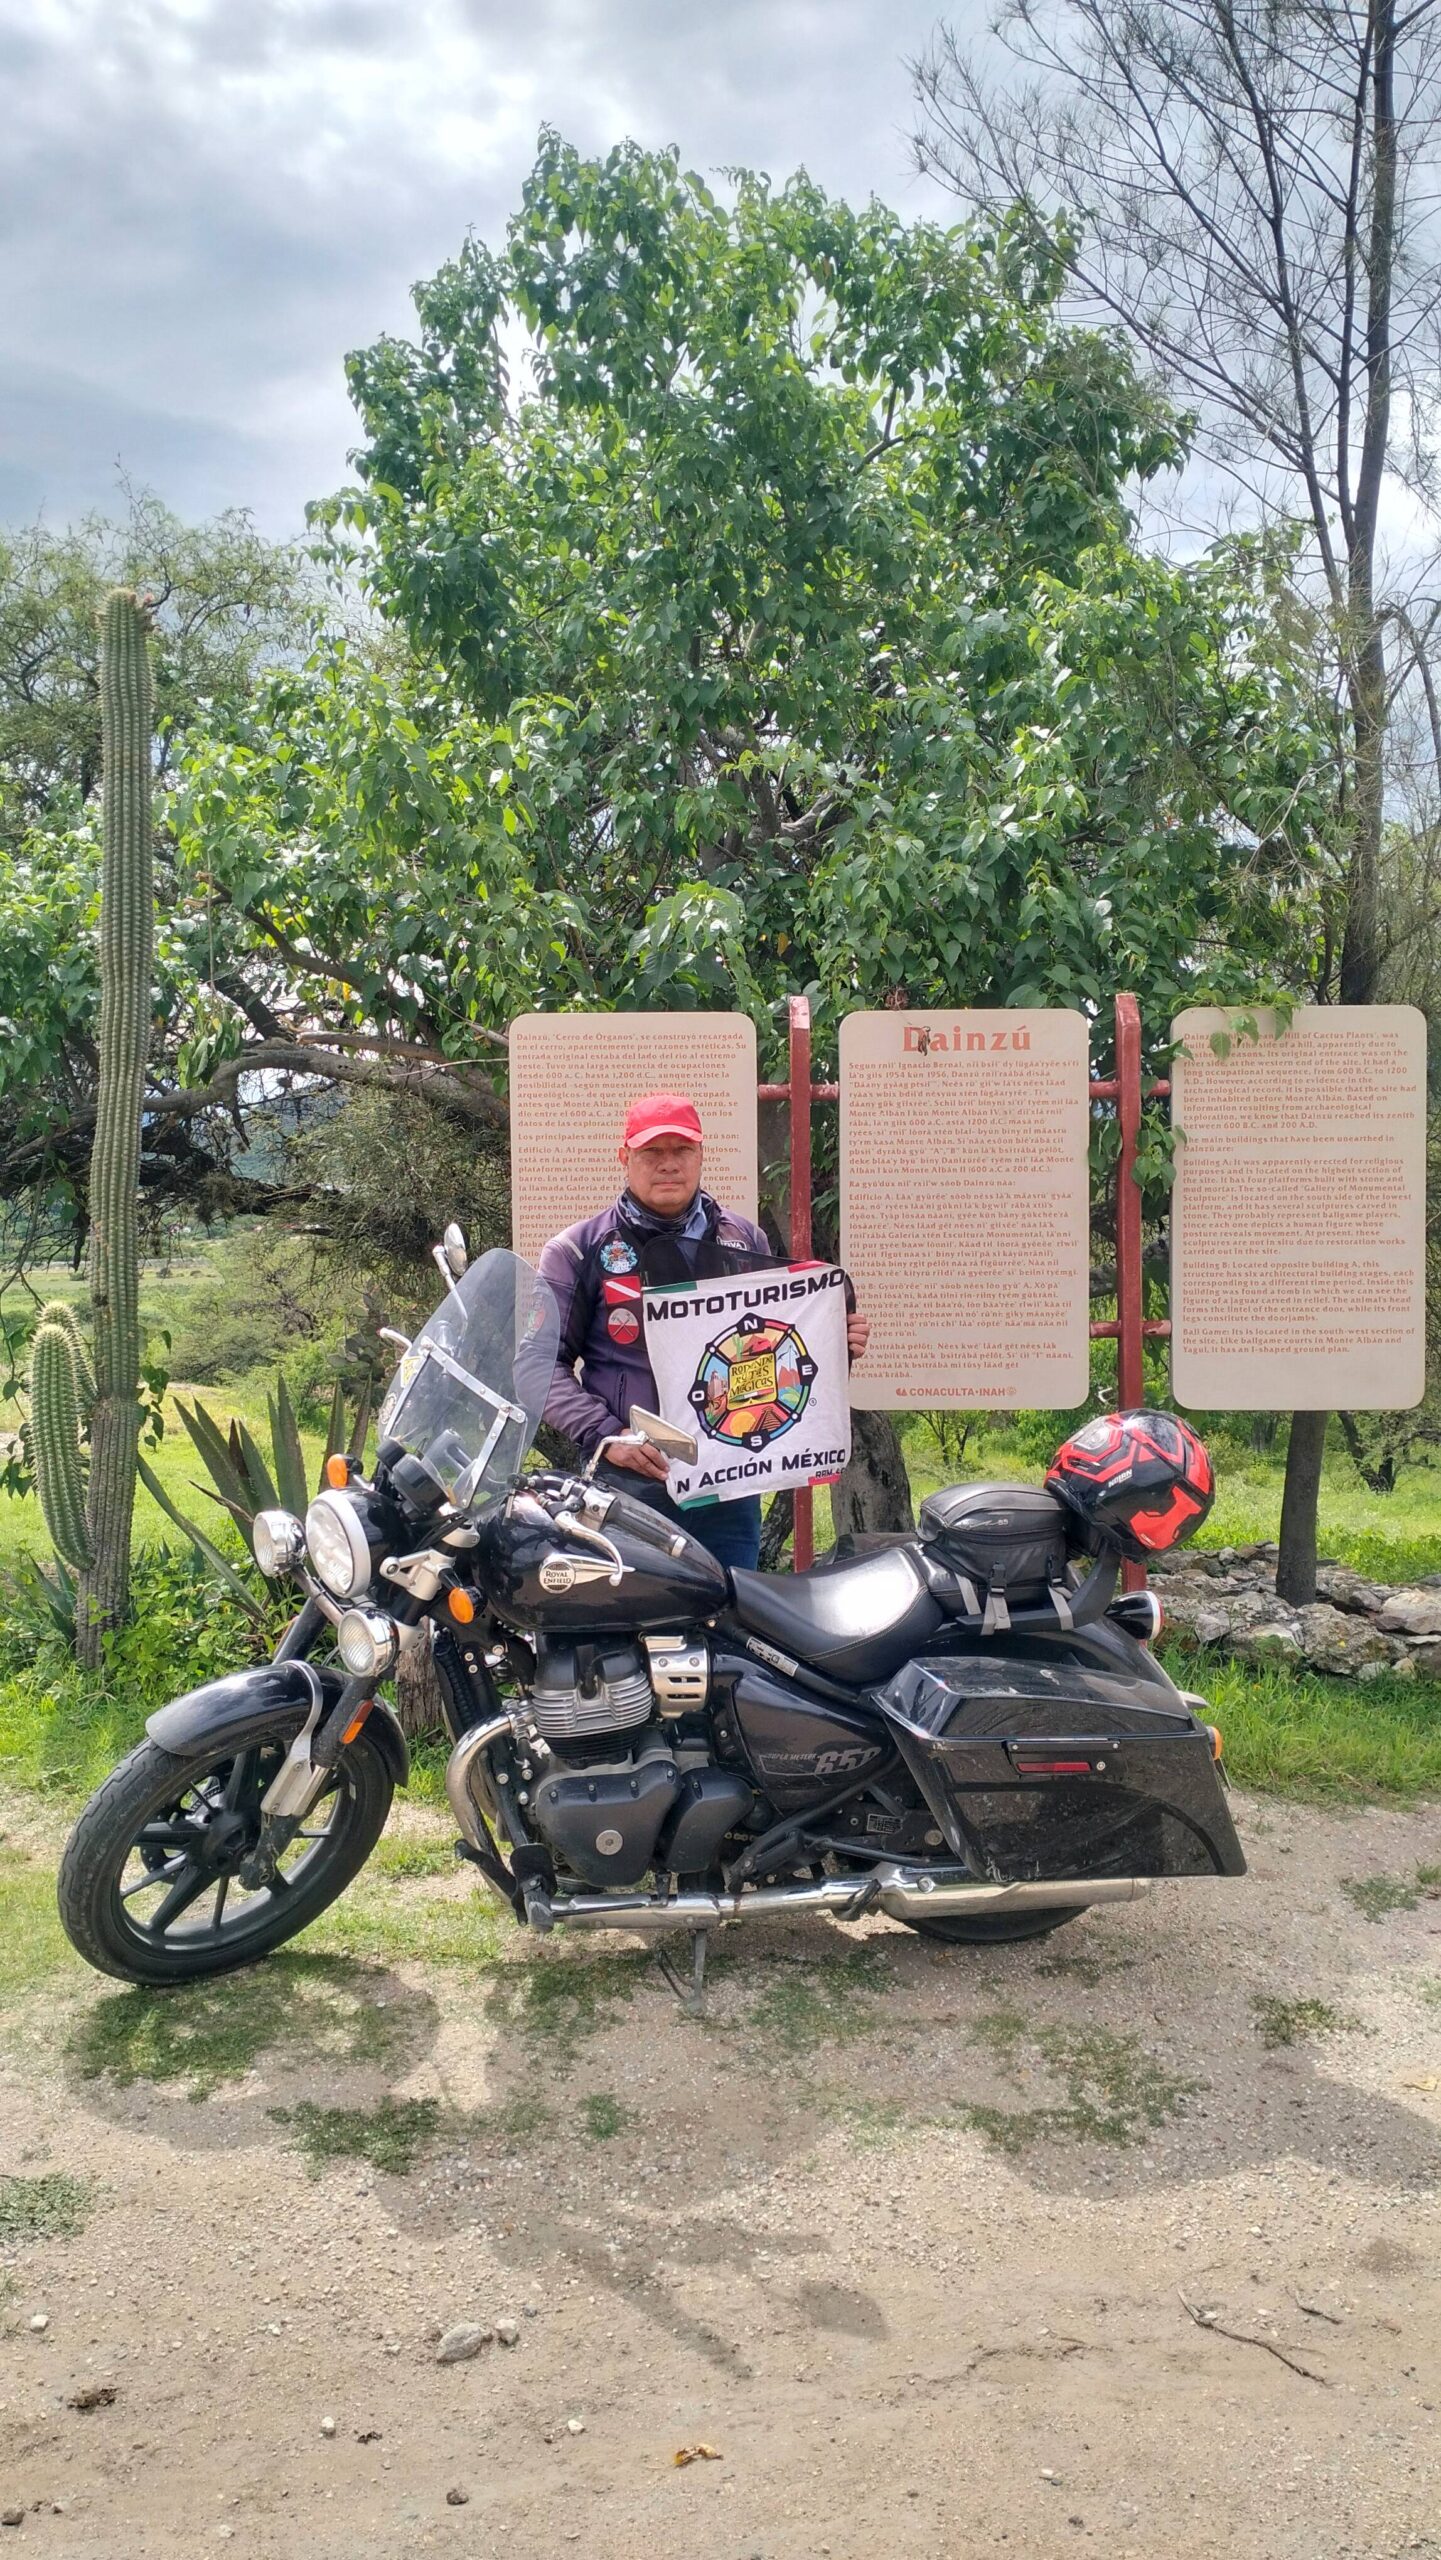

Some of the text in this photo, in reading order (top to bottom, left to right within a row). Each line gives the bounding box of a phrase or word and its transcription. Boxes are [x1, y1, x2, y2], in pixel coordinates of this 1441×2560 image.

[697, 1033, 743, 1042] recargada
[903, 1025, 1031, 1051] Dainzú
[567, 1043, 635, 1052] aparentemente
[637, 1044, 652, 1052] por
[516, 1052, 551, 1060] entrada
[553, 1052, 588, 1061] original
[590, 1052, 620, 1060] estaba
[621, 1052, 636, 1060] del
[637, 1052, 657, 1060] lado
[659, 1052, 673, 1060] del
[699, 1052, 736, 1060] extremo
[545, 1062, 566, 1070] Tuvo
[586, 1062, 609, 1071] larga
[610, 1062, 655, 1070] secuencia
[670, 1062, 726, 1071] ocupaciones
[517, 1072, 543, 1080] desde
[584, 1072, 609, 1080] hasta
[658, 1073, 691, 1081] aunque
[692, 1072, 720, 1080] existe
[1183, 1068, 1203, 1077] long
[1204, 1068, 1264, 1077] occupational
[1313, 1067, 1335, 1075] from
[517, 1081, 567, 1090] posibilidad
[602, 1081, 645, 1089] muestran
[644, 1081, 658, 1089] los
[660, 1081, 707, 1089] materiales
[1183, 1095, 1205, 1103] been
[1207, 1094, 1251, 1102] inhabited
[1253, 1094, 1283, 1102] before
[1284, 1094, 1313, 1102] Monte
[1346, 1094, 1374, 1102] Based
[517, 1100, 543, 1108] antes
[544, 1101, 560, 1109] que
[562, 1100, 592, 1108] Monte
[1182, 1103, 1372, 1113] information resulting from archaeological
[1253, 1112, 1278, 1120] know
[1280, 1112, 1299, 1120] that
[1334, 1112, 1371, 1120] reached
[1372, 1112, 1384, 1120] its
[1386, 1112, 1415, 1120] zenith
[1182, 1122, 1222, 1130] between
[1261, 1121, 1278, 1129] and
[518, 1133, 627, 1142] Los principales edificios
[1182, 1158, 1220, 1167] Building
[1262, 1157, 1312, 1167] apparently
[1313, 1157, 1348, 1165] erected
[1349, 1157, 1363, 1165] for
[1364, 1157, 1404, 1166] religious
[1182, 1261, 1220, 1270] Building
[1232, 1260, 1268, 1268] Located
[1270, 1260, 1310, 1270] opposite
[1311, 1260, 1349, 1269] building
[1362, 1260, 1379, 1268] this
[647, 1269, 845, 1321] MOTOTURISMO
[1182, 1314, 1201, 1323] legs
[1203, 1314, 1249, 1322] constitute
[1250, 1313, 1265, 1321] the
[743, 1319, 758, 1330] N
[1182, 1337, 1196, 1345] the
[1220, 1336, 1239, 1344] Like
[1240, 1336, 1282, 1346] ballgame
[1283, 1336, 1313, 1344] courts
[1325, 1336, 1354, 1344] Monte
[1384, 1336, 1402, 1344] and
[802, 1364, 812, 1376] E
[692, 1391, 705, 1401] O
[750, 1435, 763, 1446] S
[675, 1447, 845, 1493] N ACCIÓN MÉXICO
[545, 1570, 568, 1578] ROYAL
